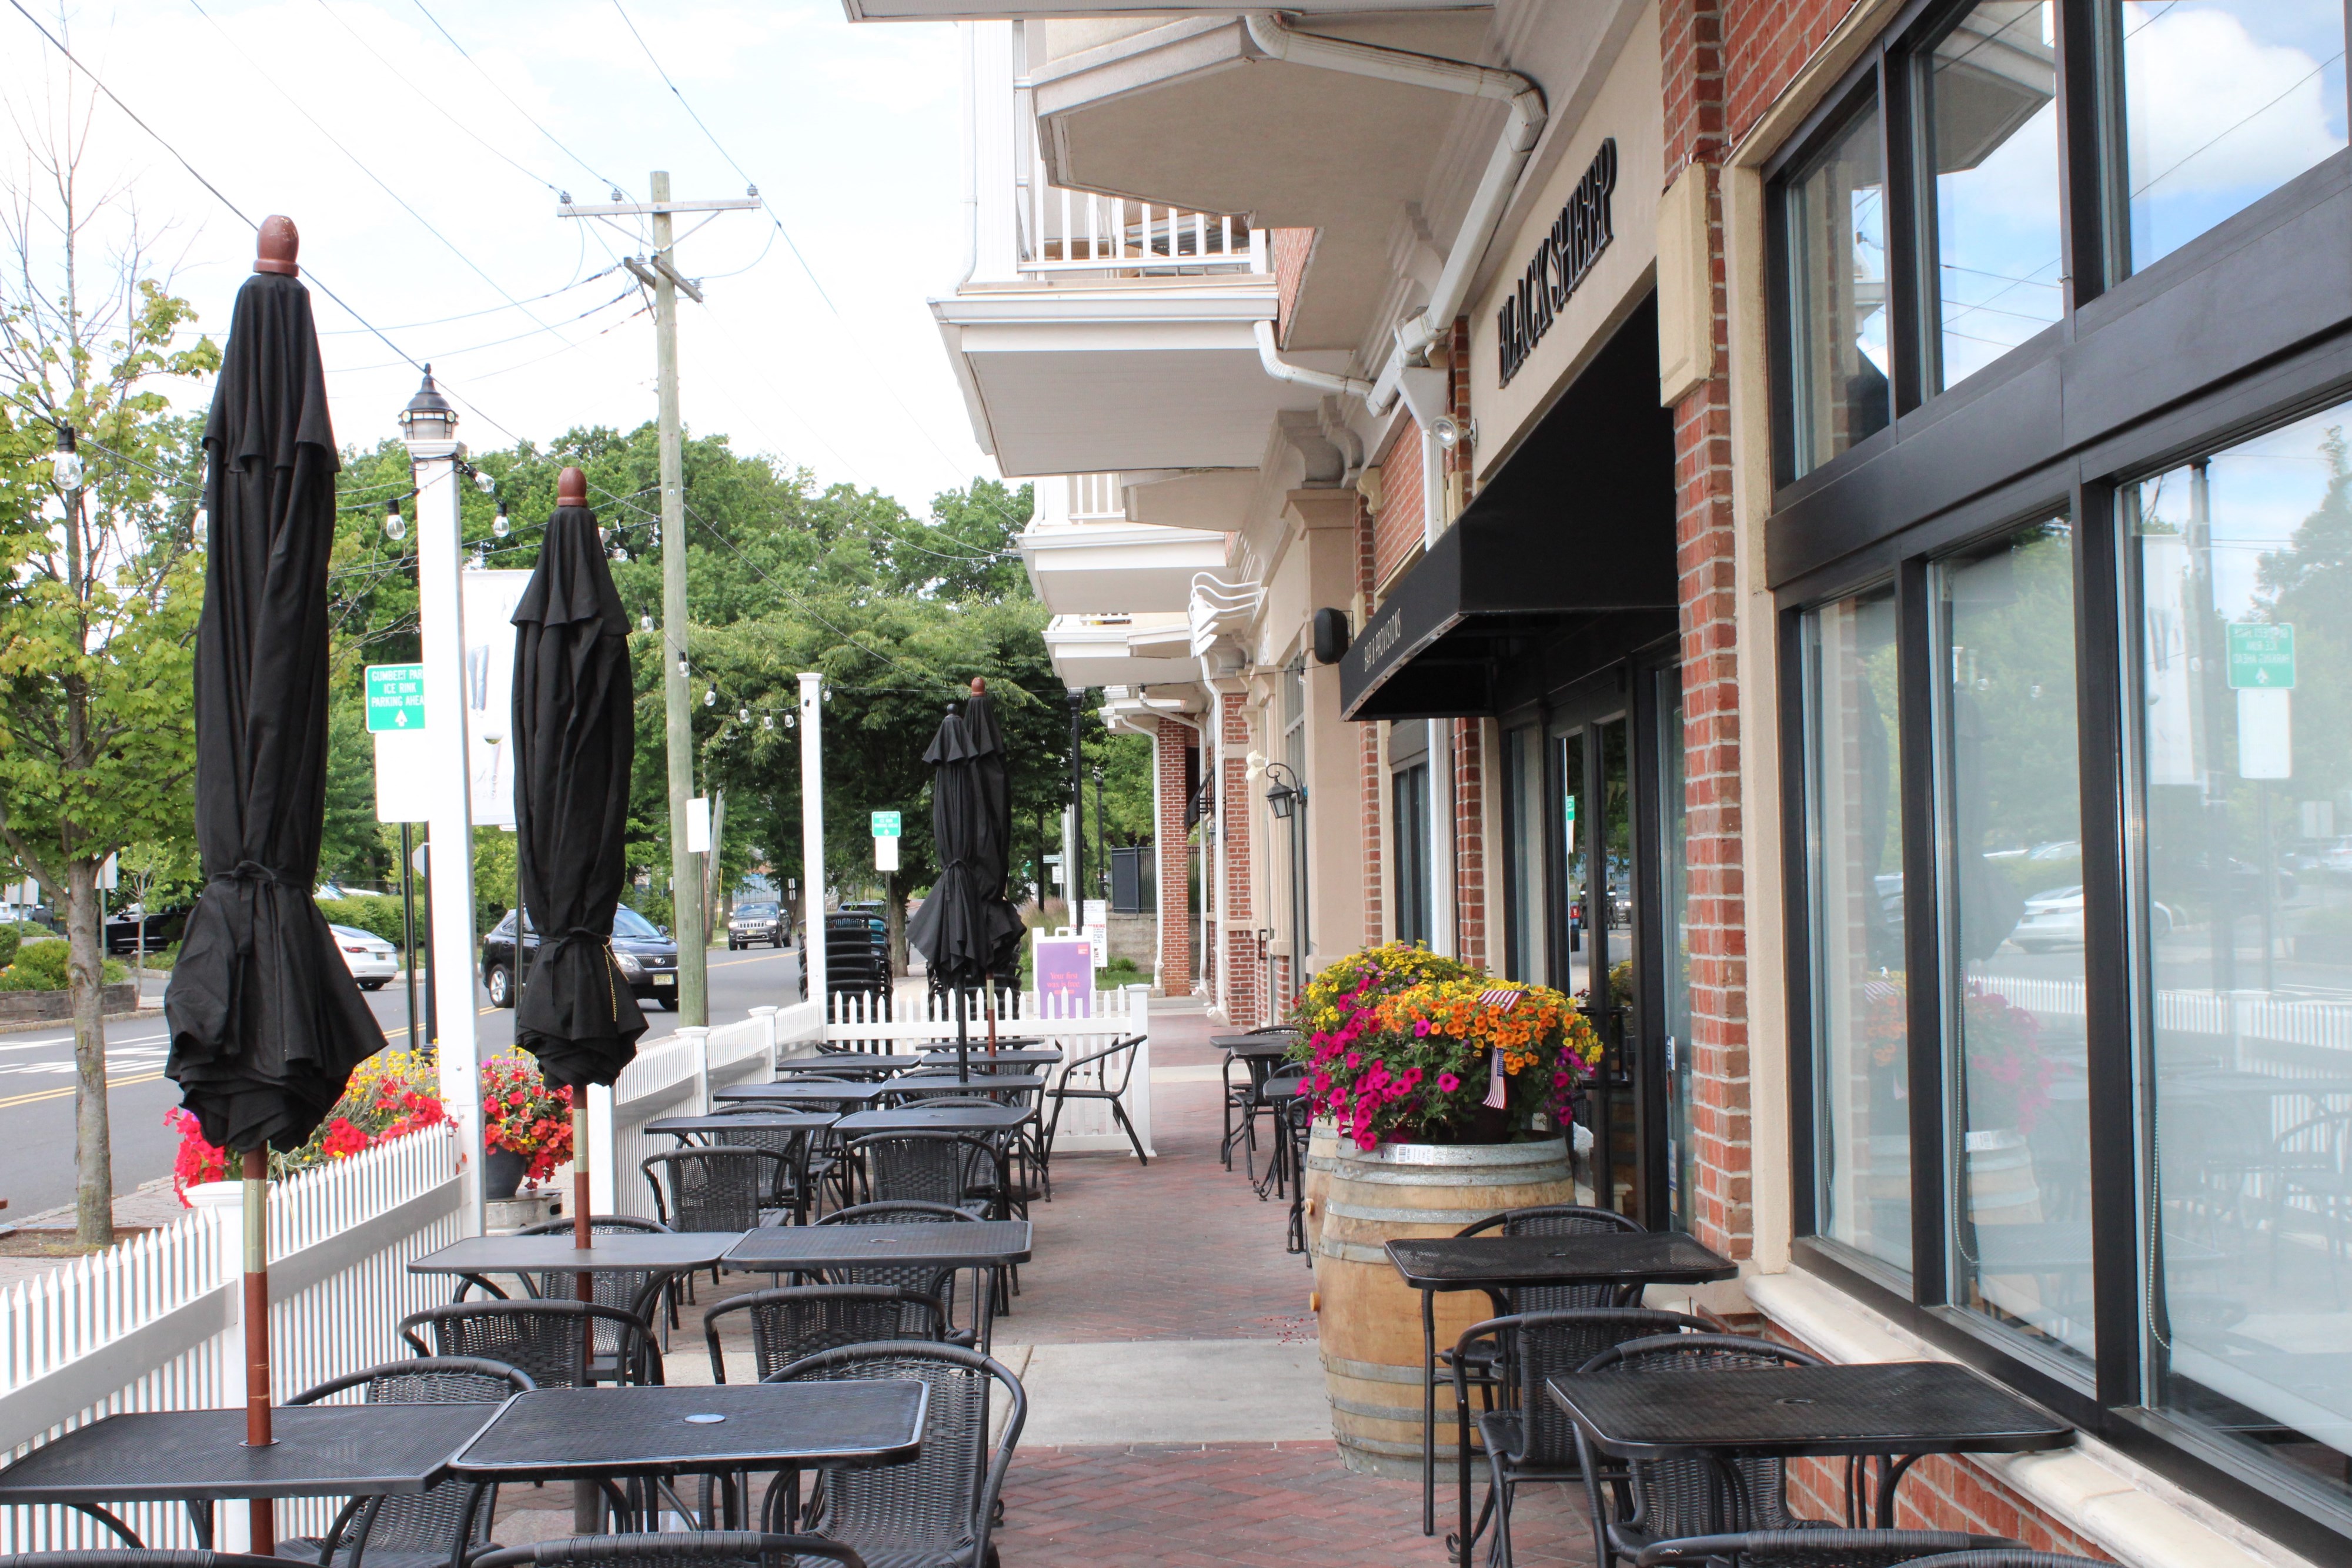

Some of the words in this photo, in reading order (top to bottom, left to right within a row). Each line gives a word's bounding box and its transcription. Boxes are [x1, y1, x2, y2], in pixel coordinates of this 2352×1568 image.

[1496, 238, 1553, 390] BLACK
[1549, 137, 1618, 314] SHEEP
[1375, 607, 1401, 661] PROVISIONS
[372, 669, 407, 682] GUMBERT
[409, 668, 423, 680] PAR
[383, 683, 396, 694] ICE
[399, 682, 417, 694] RINK
[371, 696, 403, 707] PARKING
[405, 694, 425, 706] AHEA
[1066, 971, 1078, 979] first
